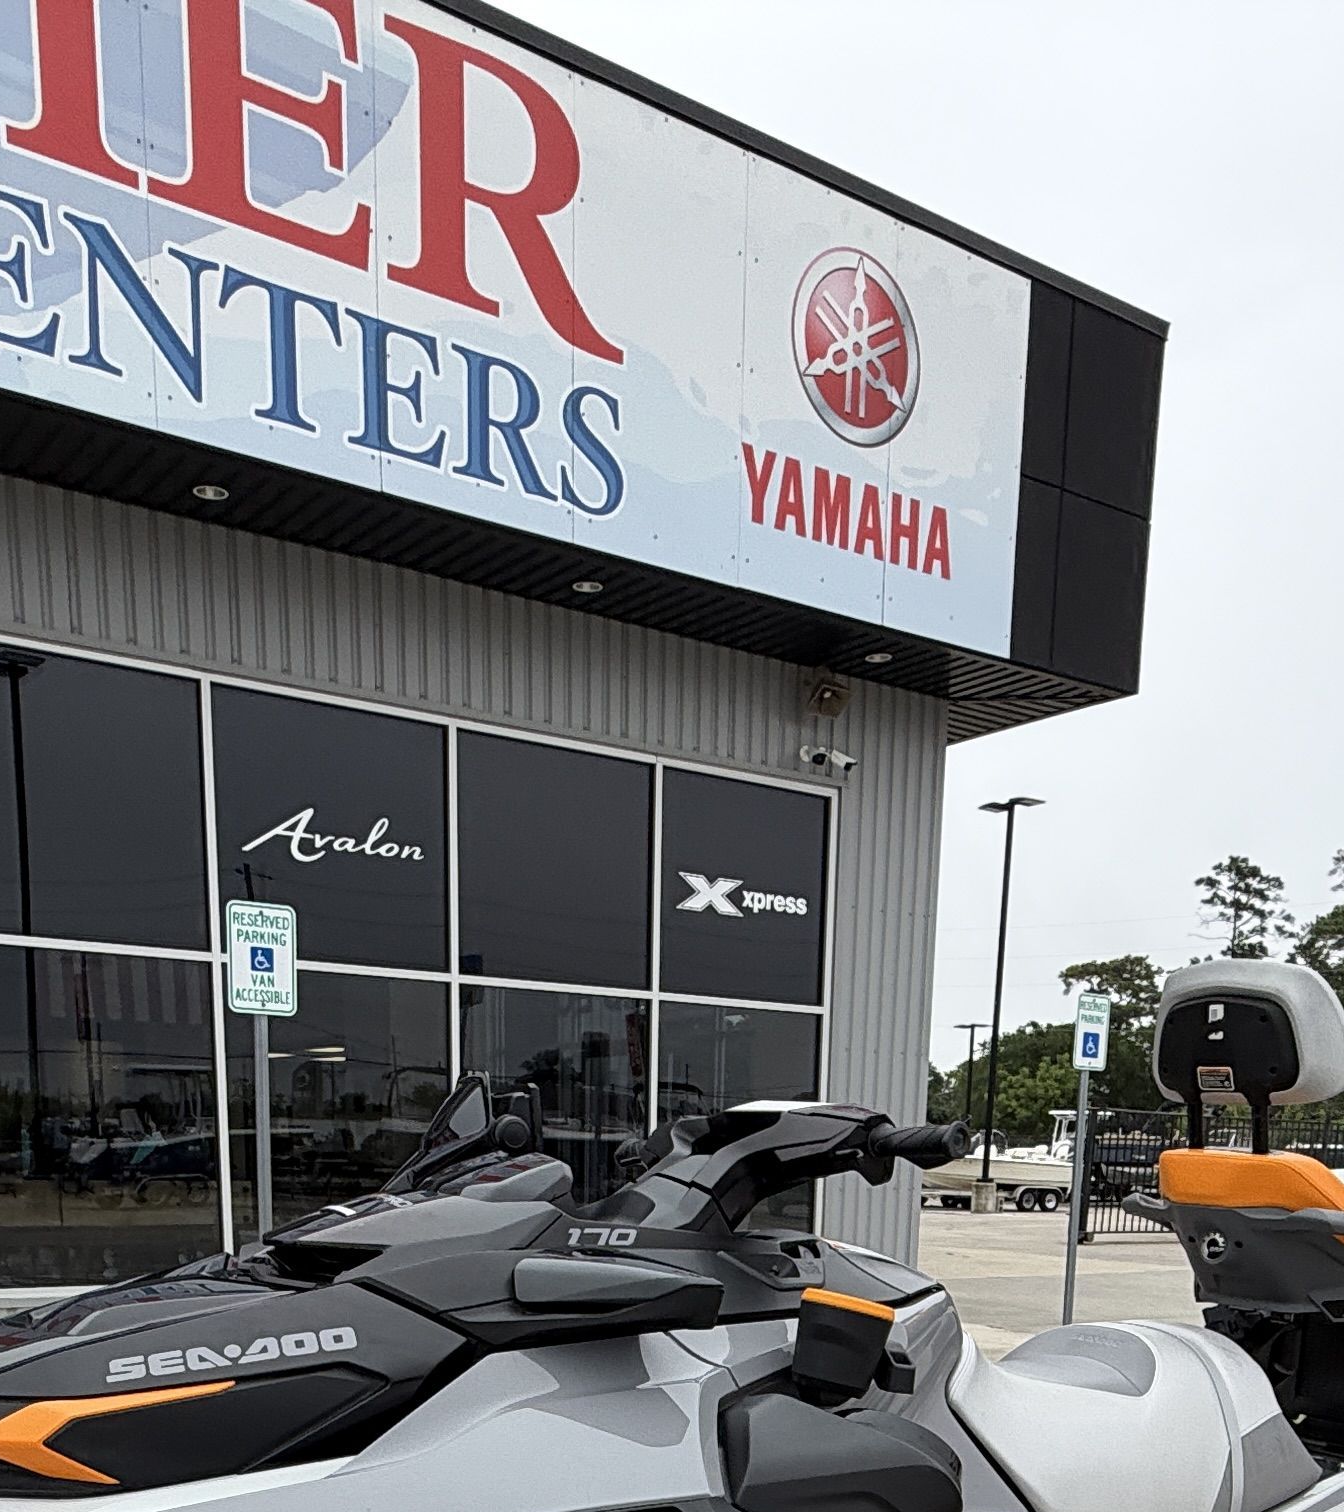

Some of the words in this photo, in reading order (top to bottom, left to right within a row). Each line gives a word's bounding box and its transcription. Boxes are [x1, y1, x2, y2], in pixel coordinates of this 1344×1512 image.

[743, 443, 952, 580] YAMAHA
[241, 807, 424, 862] Avalon
[742, 890, 808, 915] xpress
[233, 911, 290, 930] RESERVED
[236, 929, 287, 947] PARKING
[250, 974, 275, 988] VAN
[235, 989, 291, 1006] ACCESSIBLE
[567, 1227, 638, 1247] 170
